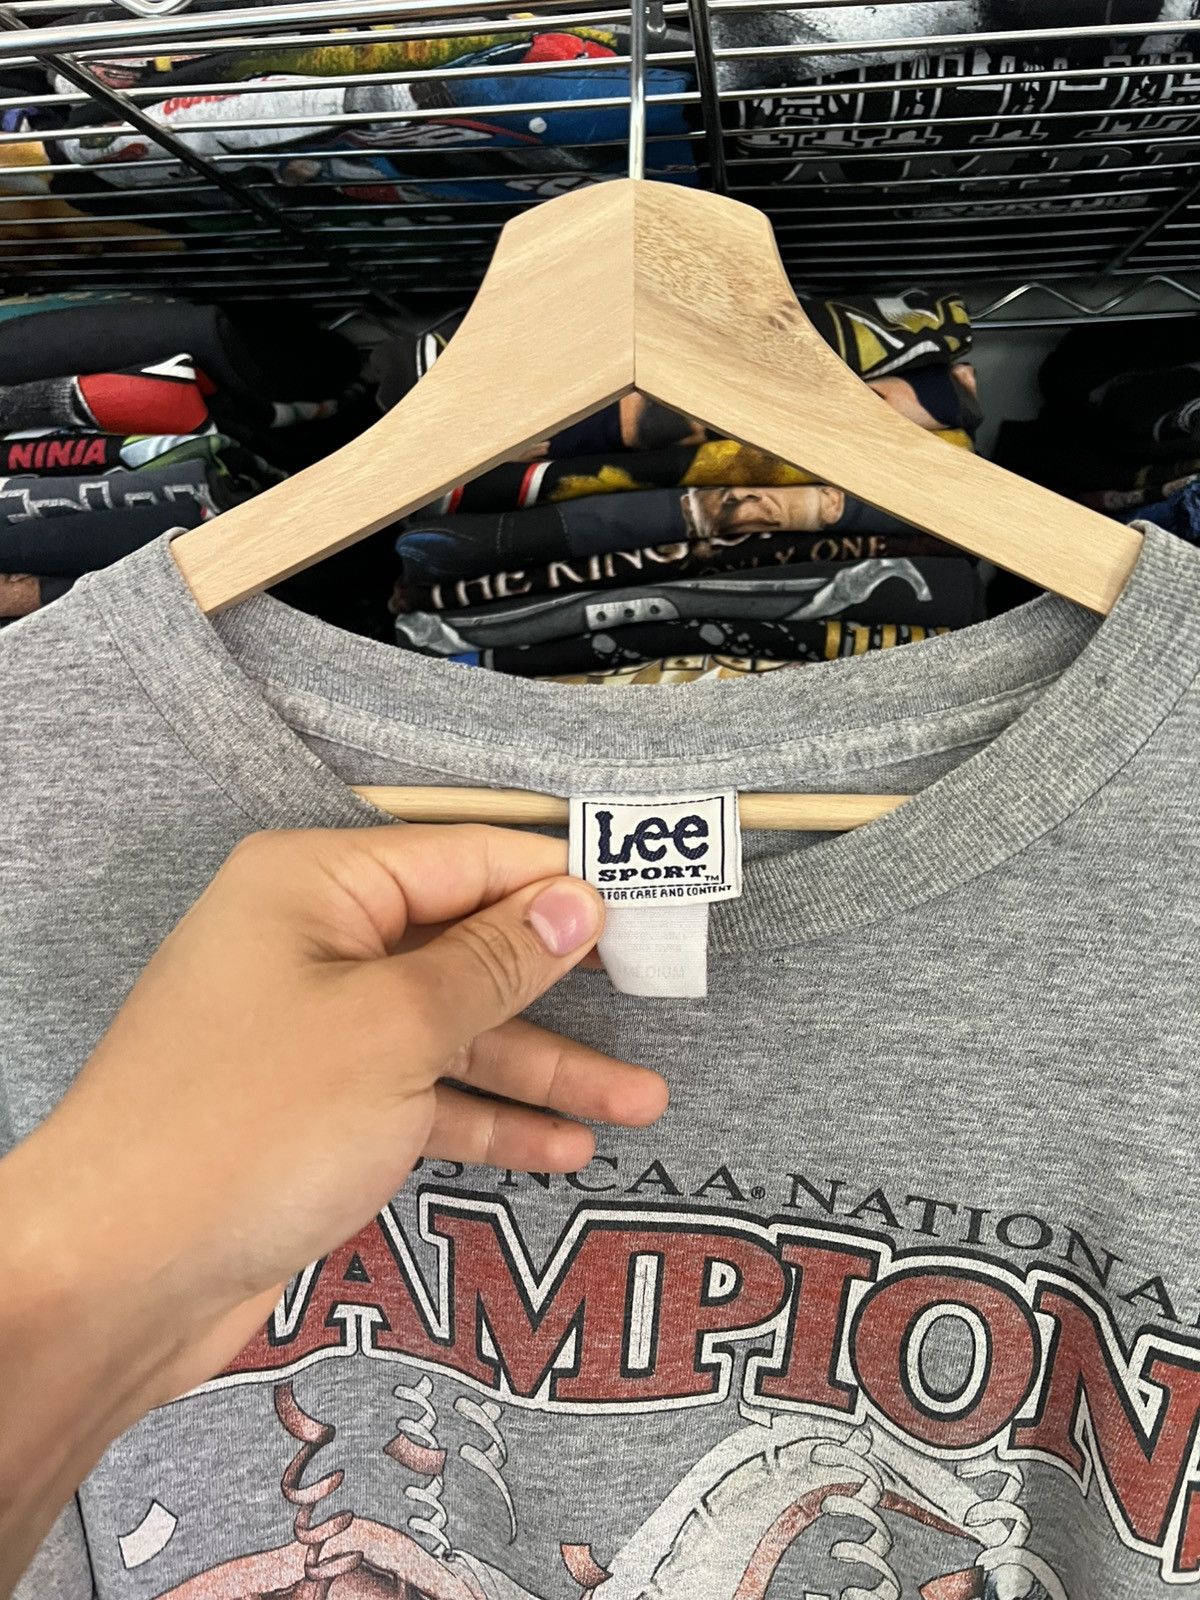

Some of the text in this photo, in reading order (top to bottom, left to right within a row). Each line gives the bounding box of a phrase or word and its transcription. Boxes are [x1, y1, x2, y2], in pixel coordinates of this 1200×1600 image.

[8, 438, 107, 470] NINJA
[595, 811, 709, 864] Lee
[598, 865, 707, 881] SPORT
[607, 891, 628, 900] FOR
[630, 889, 657, 899] CARE
[660, 887, 684, 898] AND
[687, 885, 732, 896] CONTENT
[783, 1172, 1200, 1329] NATIONA
[150, 1184, 1200, 1584] AMPION
